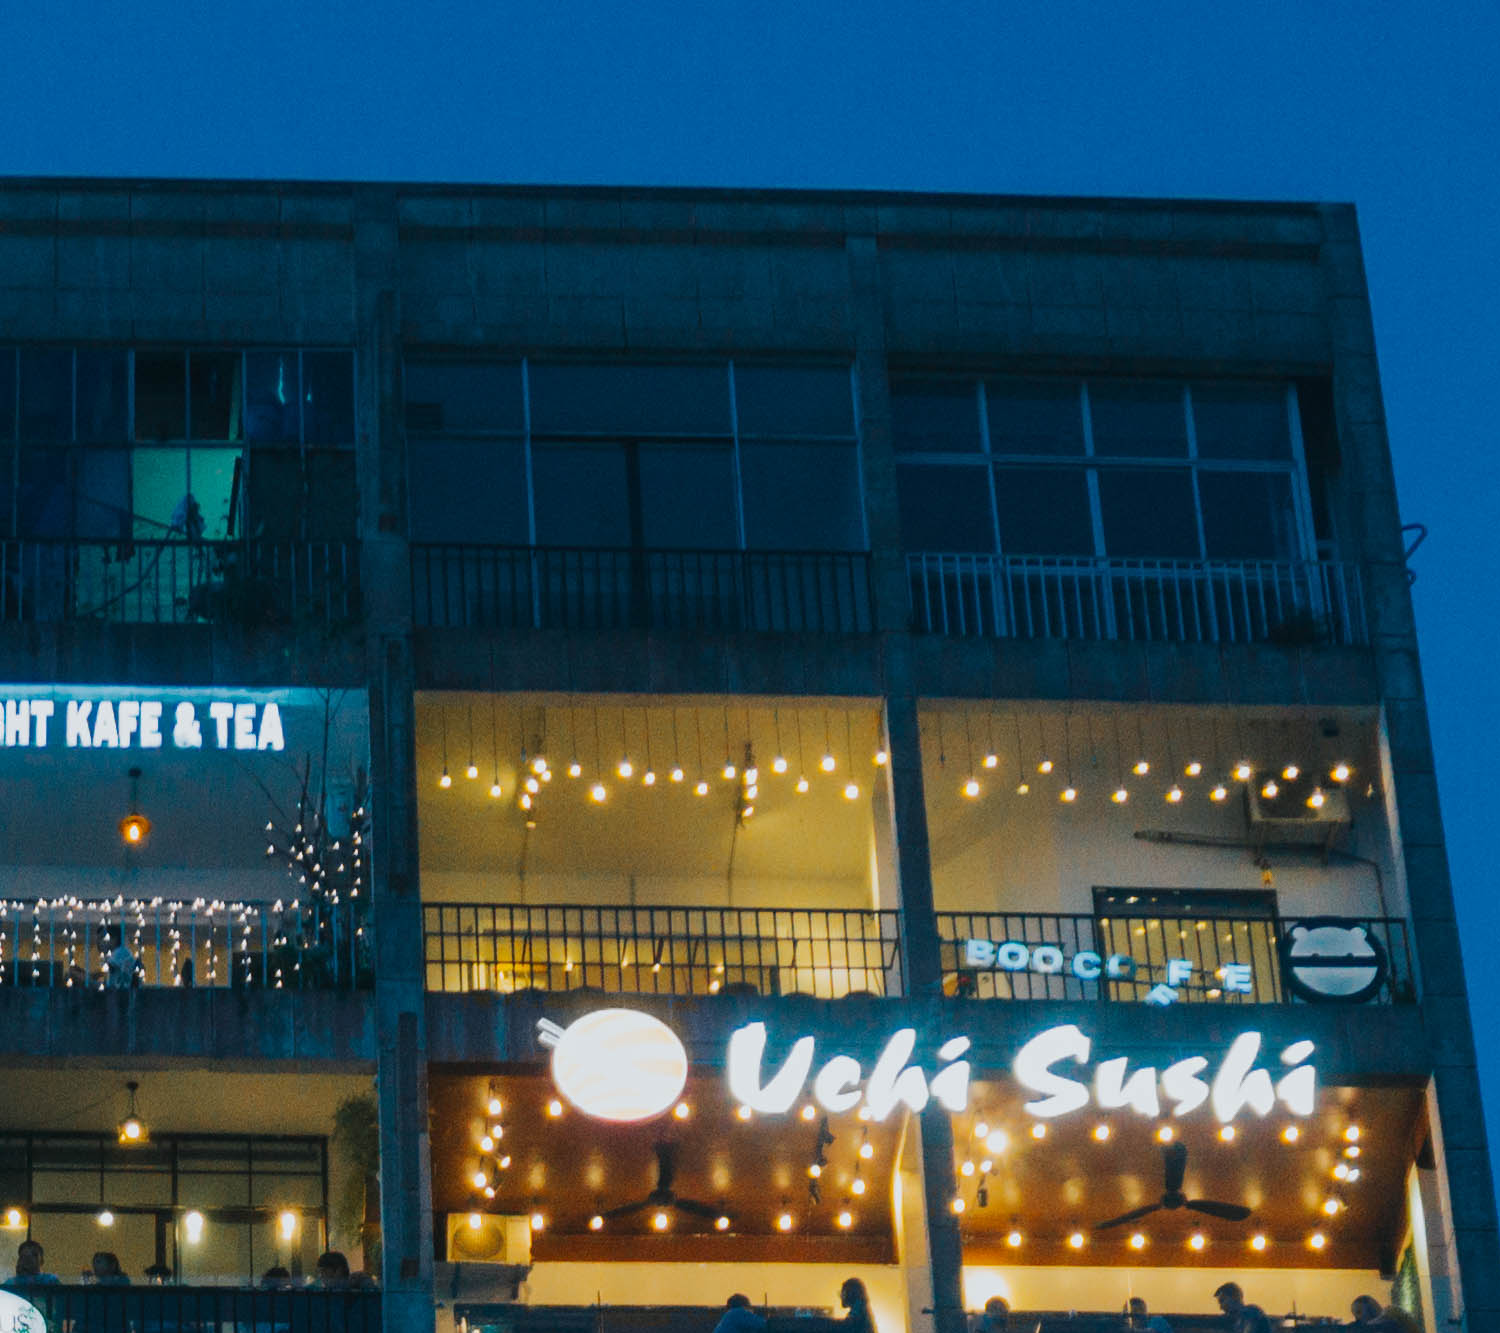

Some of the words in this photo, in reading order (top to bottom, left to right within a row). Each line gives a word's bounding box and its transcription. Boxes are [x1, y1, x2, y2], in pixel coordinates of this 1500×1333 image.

[66, 700, 162, 749] KAFE
[174, 701, 202, 748] &
[211, 702, 285, 751] TEA
[965, 938, 1065, 974] BOO
[728, 1019, 972, 1122] Uchi
[1015, 1022, 1317, 1121] Sushi
